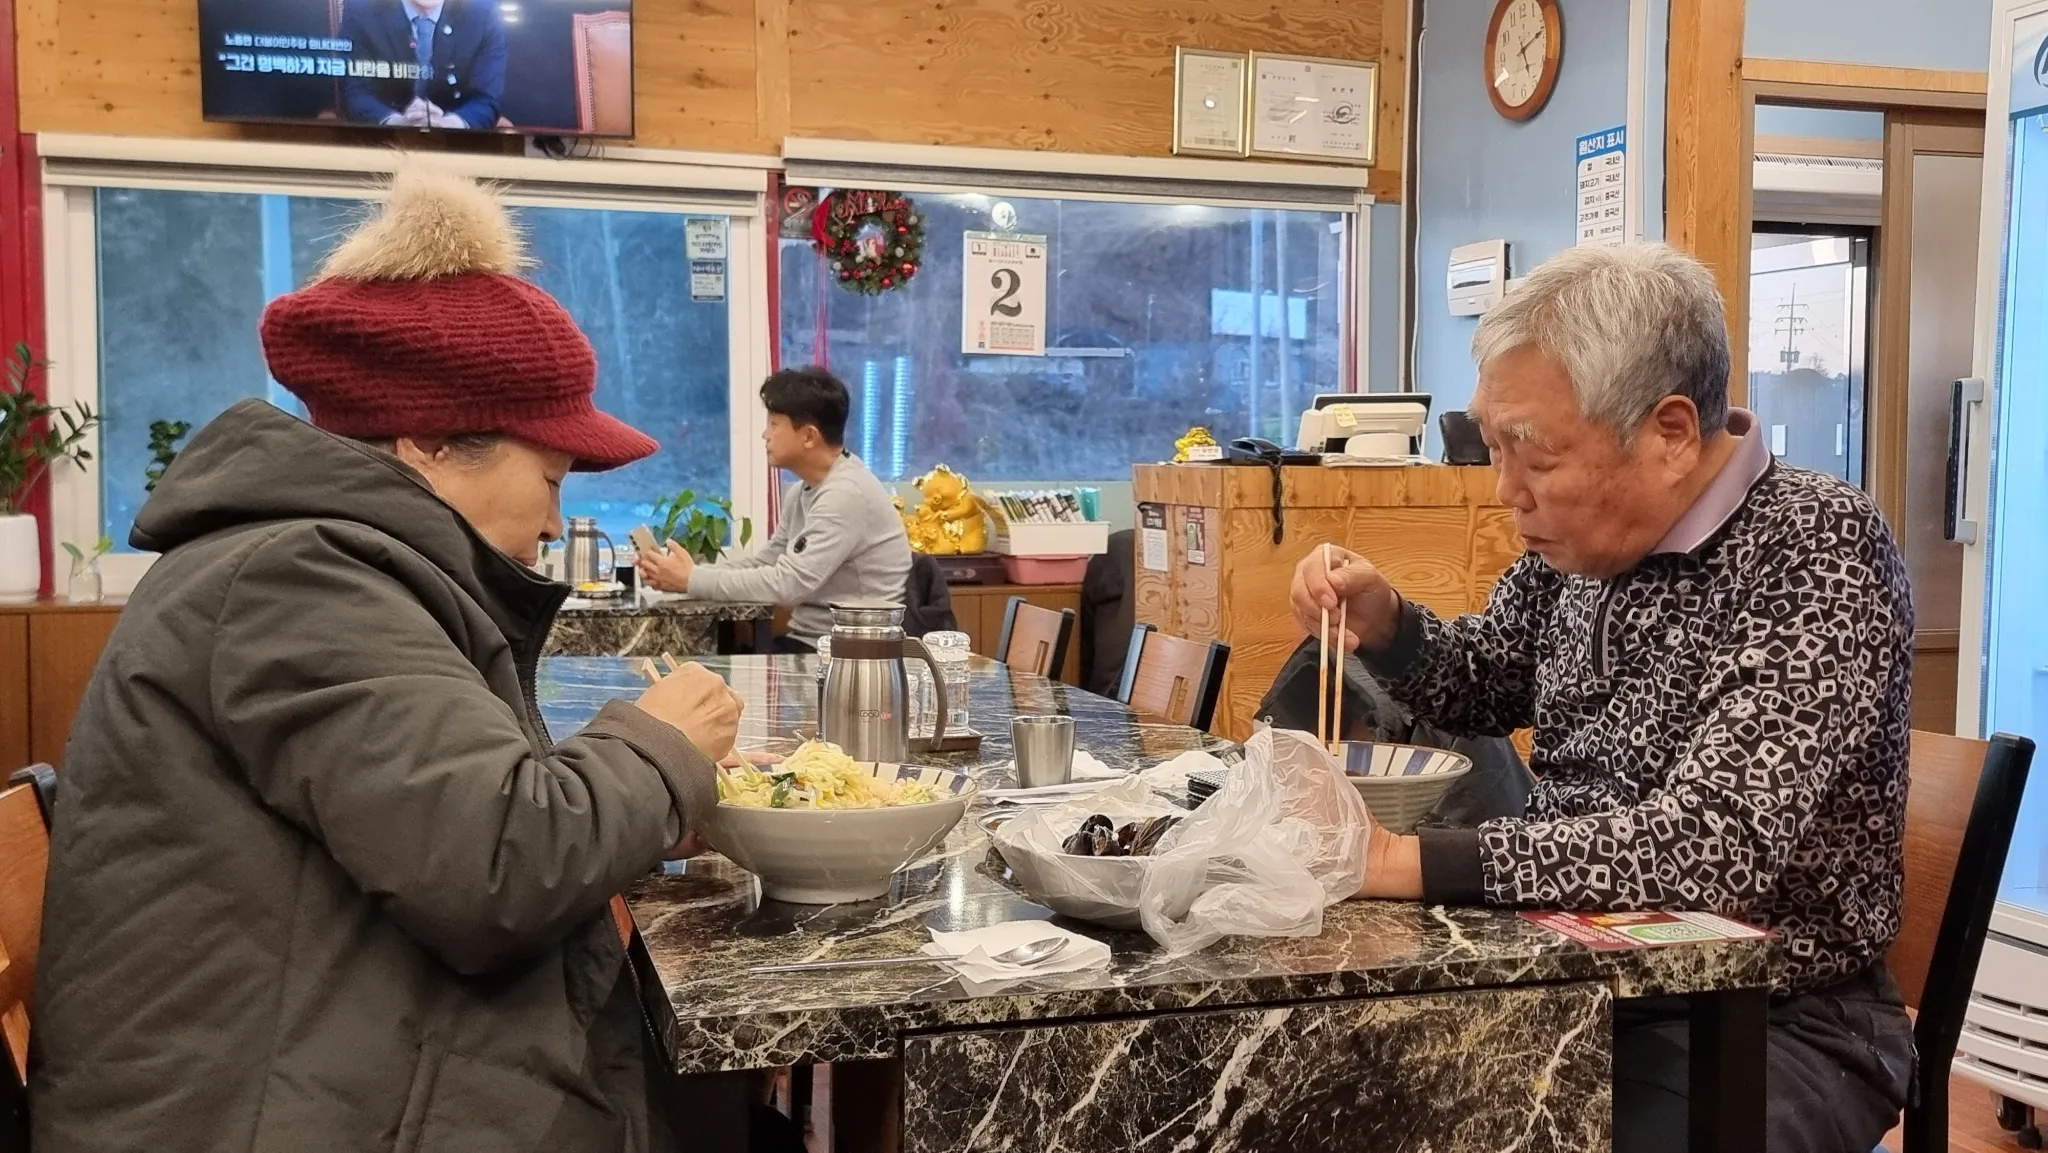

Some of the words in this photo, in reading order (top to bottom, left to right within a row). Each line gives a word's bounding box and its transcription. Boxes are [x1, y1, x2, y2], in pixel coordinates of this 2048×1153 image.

[254, 36, 307, 50] 더불어민주당
[258, 55, 315, 75] 명백하게
[317, 57, 346, 76] 지금
[348, 59, 390, 78] 내란을
[1579, 135, 1604, 156] 원산지
[1606, 130, 1624, 149] 표시
[1605, 156, 1620, 166] 국내산
[1580, 177, 1599, 190] 돼지고기
[1605, 172, 1620, 183] 국내산
[1605, 189, 1620, 201] 중국산
[1605, 206, 1619, 218] 중국산
[991, 268, 1022, 317] 2
